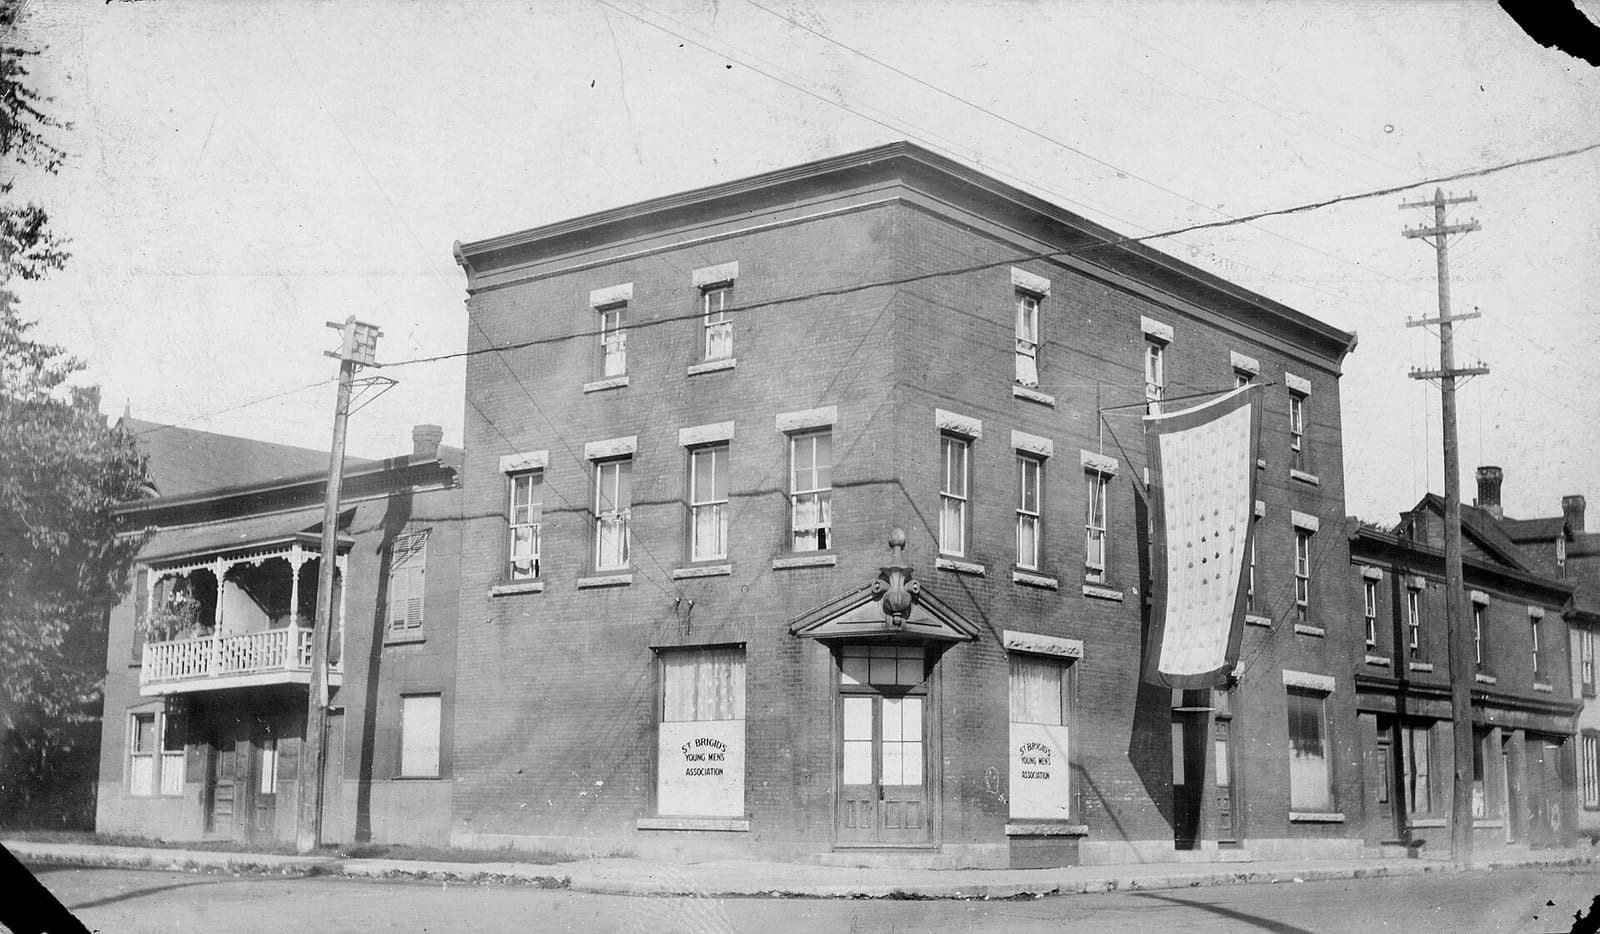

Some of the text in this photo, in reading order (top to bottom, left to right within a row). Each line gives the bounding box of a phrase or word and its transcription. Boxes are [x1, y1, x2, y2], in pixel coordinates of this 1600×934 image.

[681, 741, 691, 754] ST
[685, 753, 706, 762] YOUNG
[1021, 757, 1037, 765] YOUNG
[686, 767, 724, 776] ASSOCIATION
[1022, 770, 1050, 780] ASSOCIATION
